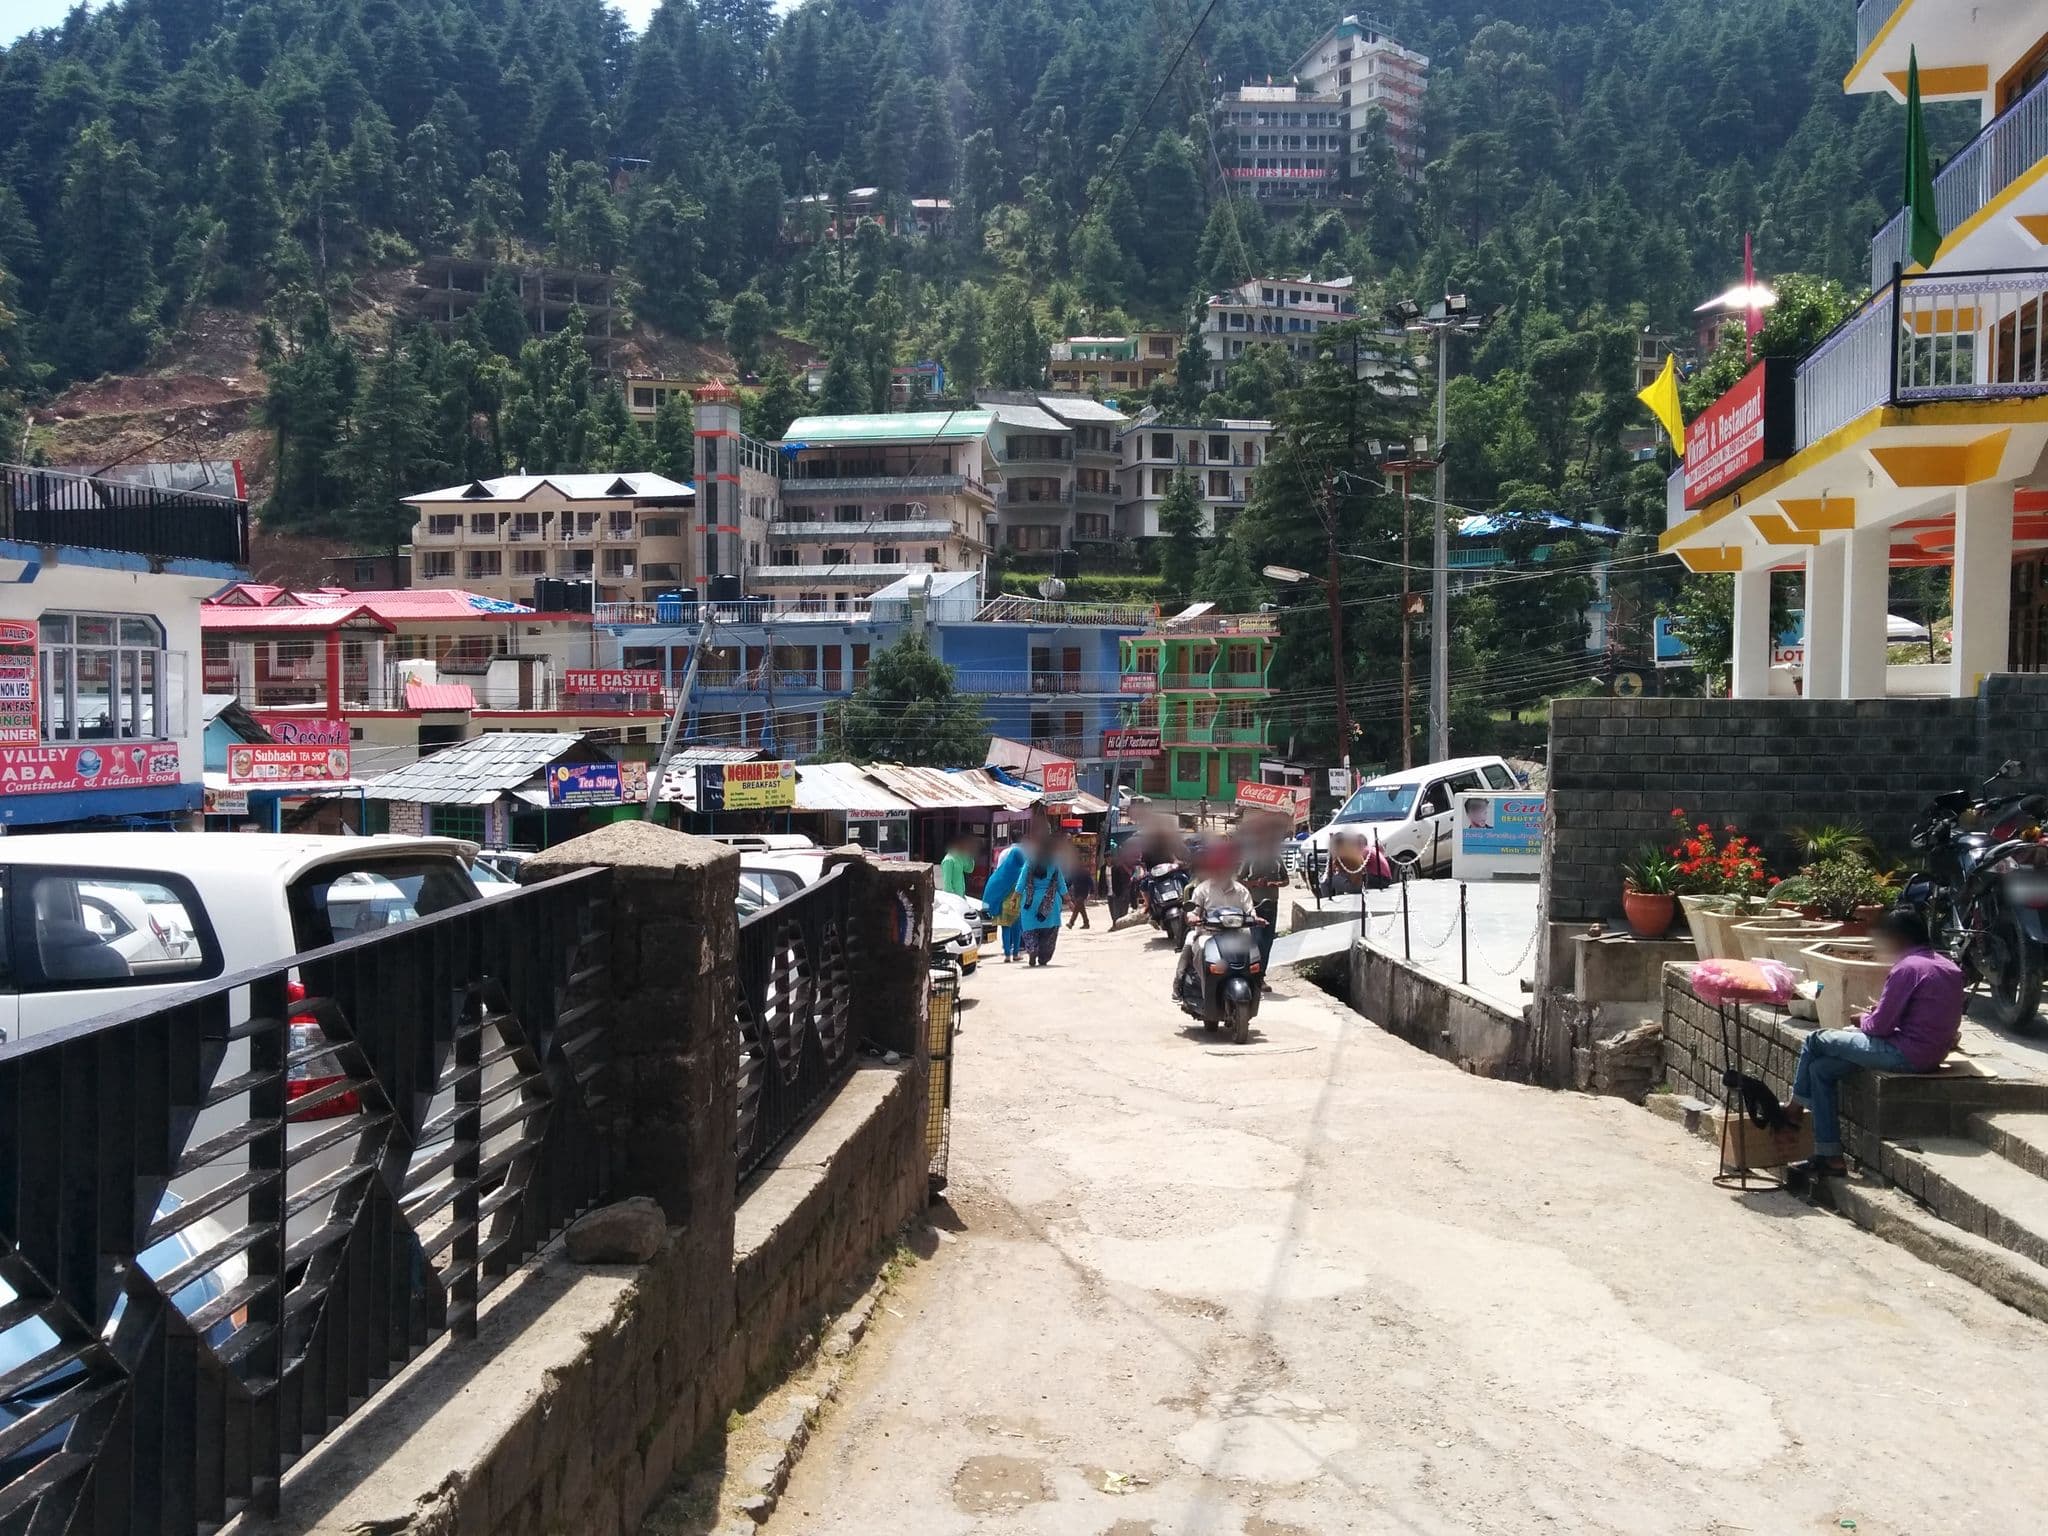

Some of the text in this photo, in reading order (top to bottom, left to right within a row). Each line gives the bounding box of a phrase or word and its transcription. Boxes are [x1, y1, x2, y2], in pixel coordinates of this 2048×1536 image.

[1710, 422, 1717, 450] &
[1719, 386, 1761, 445] Restaurant
[567, 674, 658, 686] THE CASTLE
[17, 684, 30, 697] VEG
[3, 748, 69, 764] VALLEY
[254, 750, 326, 762] Subhash TEA SHOP
[83, 777, 98, 787] &
[101, 773, 143, 786] Italian
[146, 772, 176, 783] Food
[578, 776, 618, 789] Tea Shop
[742, 780, 781, 790] BREAKFAST
